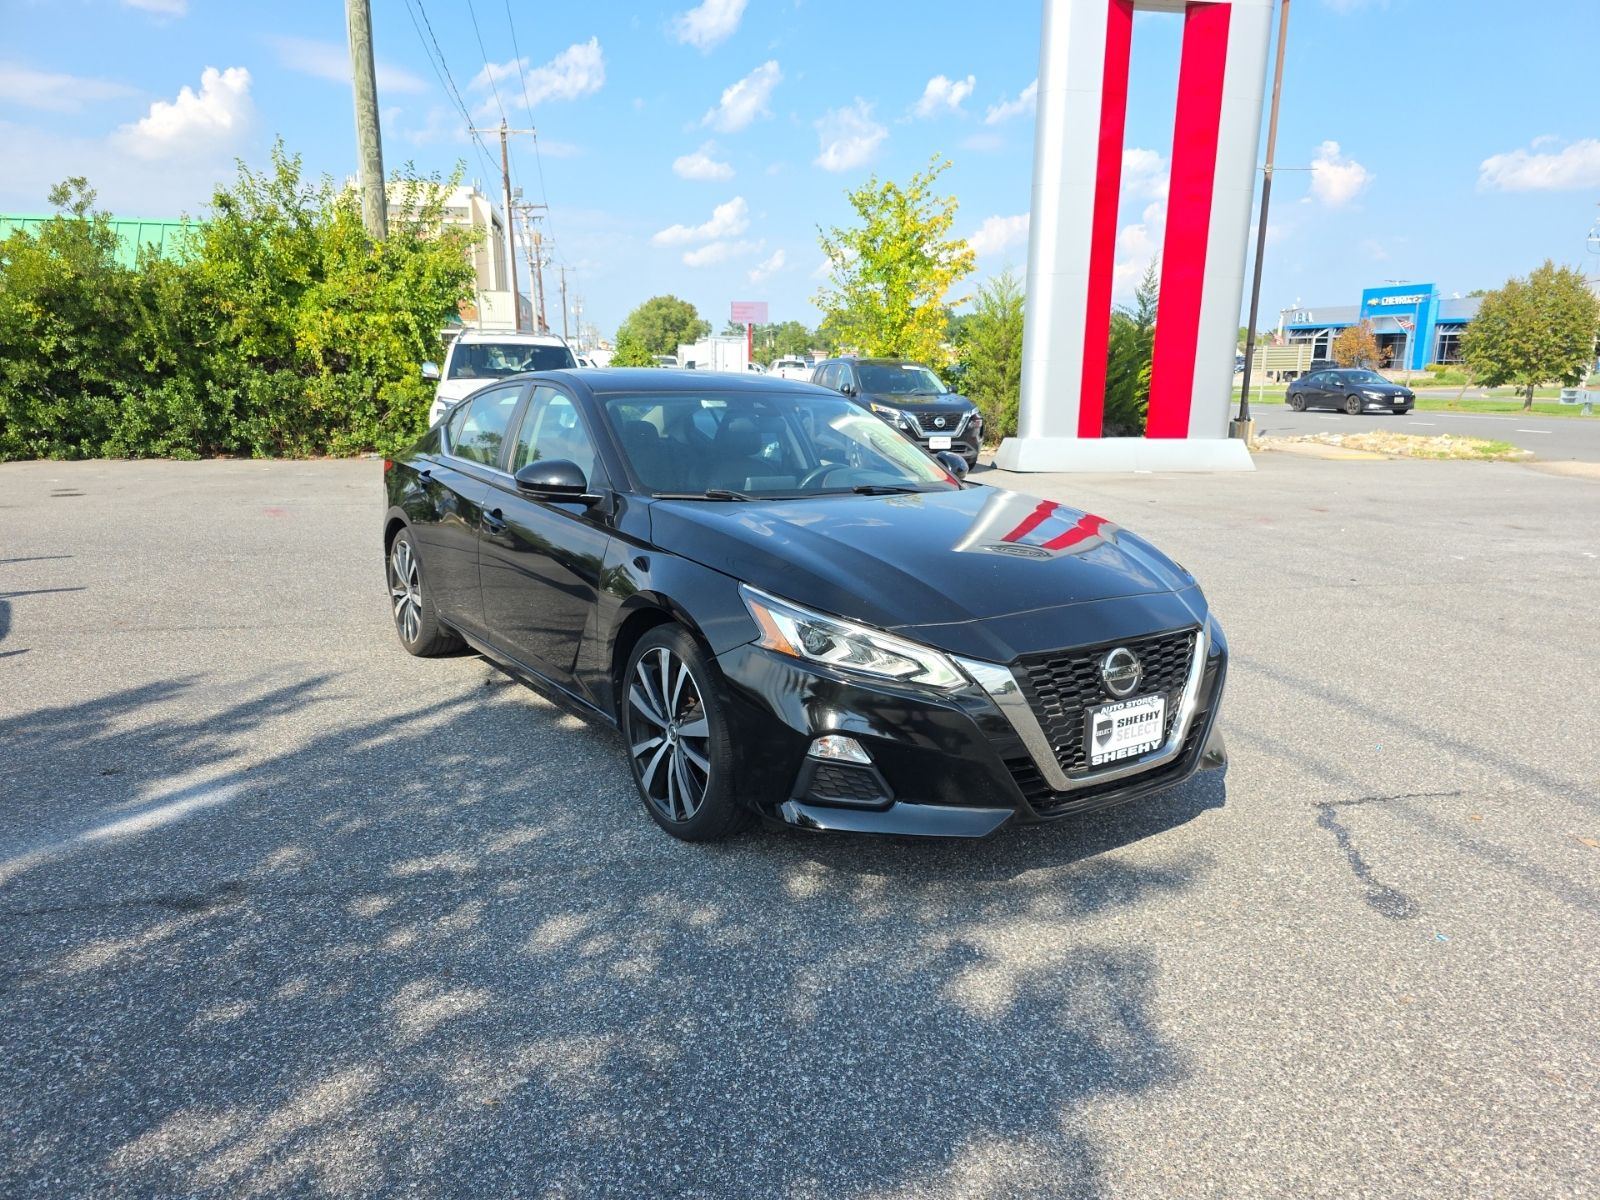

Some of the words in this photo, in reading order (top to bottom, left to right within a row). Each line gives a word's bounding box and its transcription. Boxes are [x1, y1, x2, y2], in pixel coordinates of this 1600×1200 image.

[1101, 704, 1125, 714] AUTO
[1126, 695, 1158, 707] STORES
[1117, 710, 1160, 727] SHEEHY
[1096, 728, 1112, 736] SELECT
[1116, 721, 1159, 742] SELECT
[1092, 740, 1160, 765] SHEEHY
